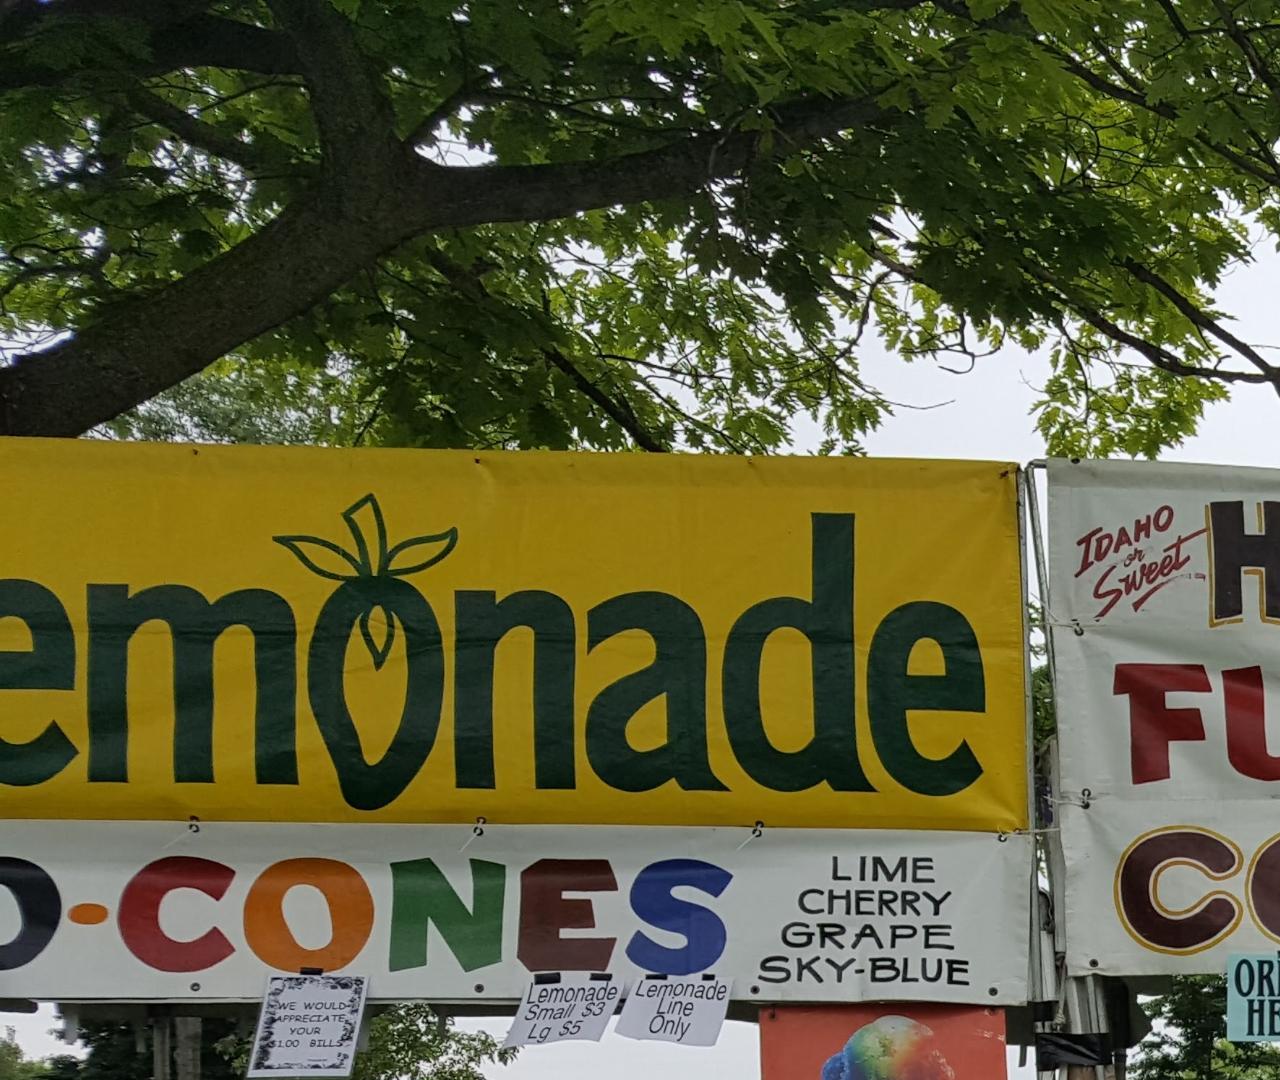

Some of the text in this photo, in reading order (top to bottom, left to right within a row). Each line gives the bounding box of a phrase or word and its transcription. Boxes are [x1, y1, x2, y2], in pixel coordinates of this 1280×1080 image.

[1074, 505, 1174, 578] IDAHO
[1123, 547, 1146, 568] or
[1093, 527, 1208, 621] Sweet
[0, 511, 988, 811] emonade
[832, 856, 935, 883] LIME
[798, 888, 952, 917] CHERRY
[781, 922, 955, 950] GRAPE
[758, 955, 970, 986] SKY-BLUE
[526, 982, 618, 1005] Lemonade
[635, 979, 728, 1001] Lemonade
[278, 1002, 347, 1011] WE WOULD
[524, 1001, 606, 1021] Small $3
[656, 997, 694, 1017] Line
[276, 1014, 345, 1023] APPRECIATE
[648, 1014, 691, 1042] Only
[289, 1027, 321, 1036] YOUR
[528, 1020, 583, 1043] Lg $5
[309, 1040, 343, 1048] BILLS
